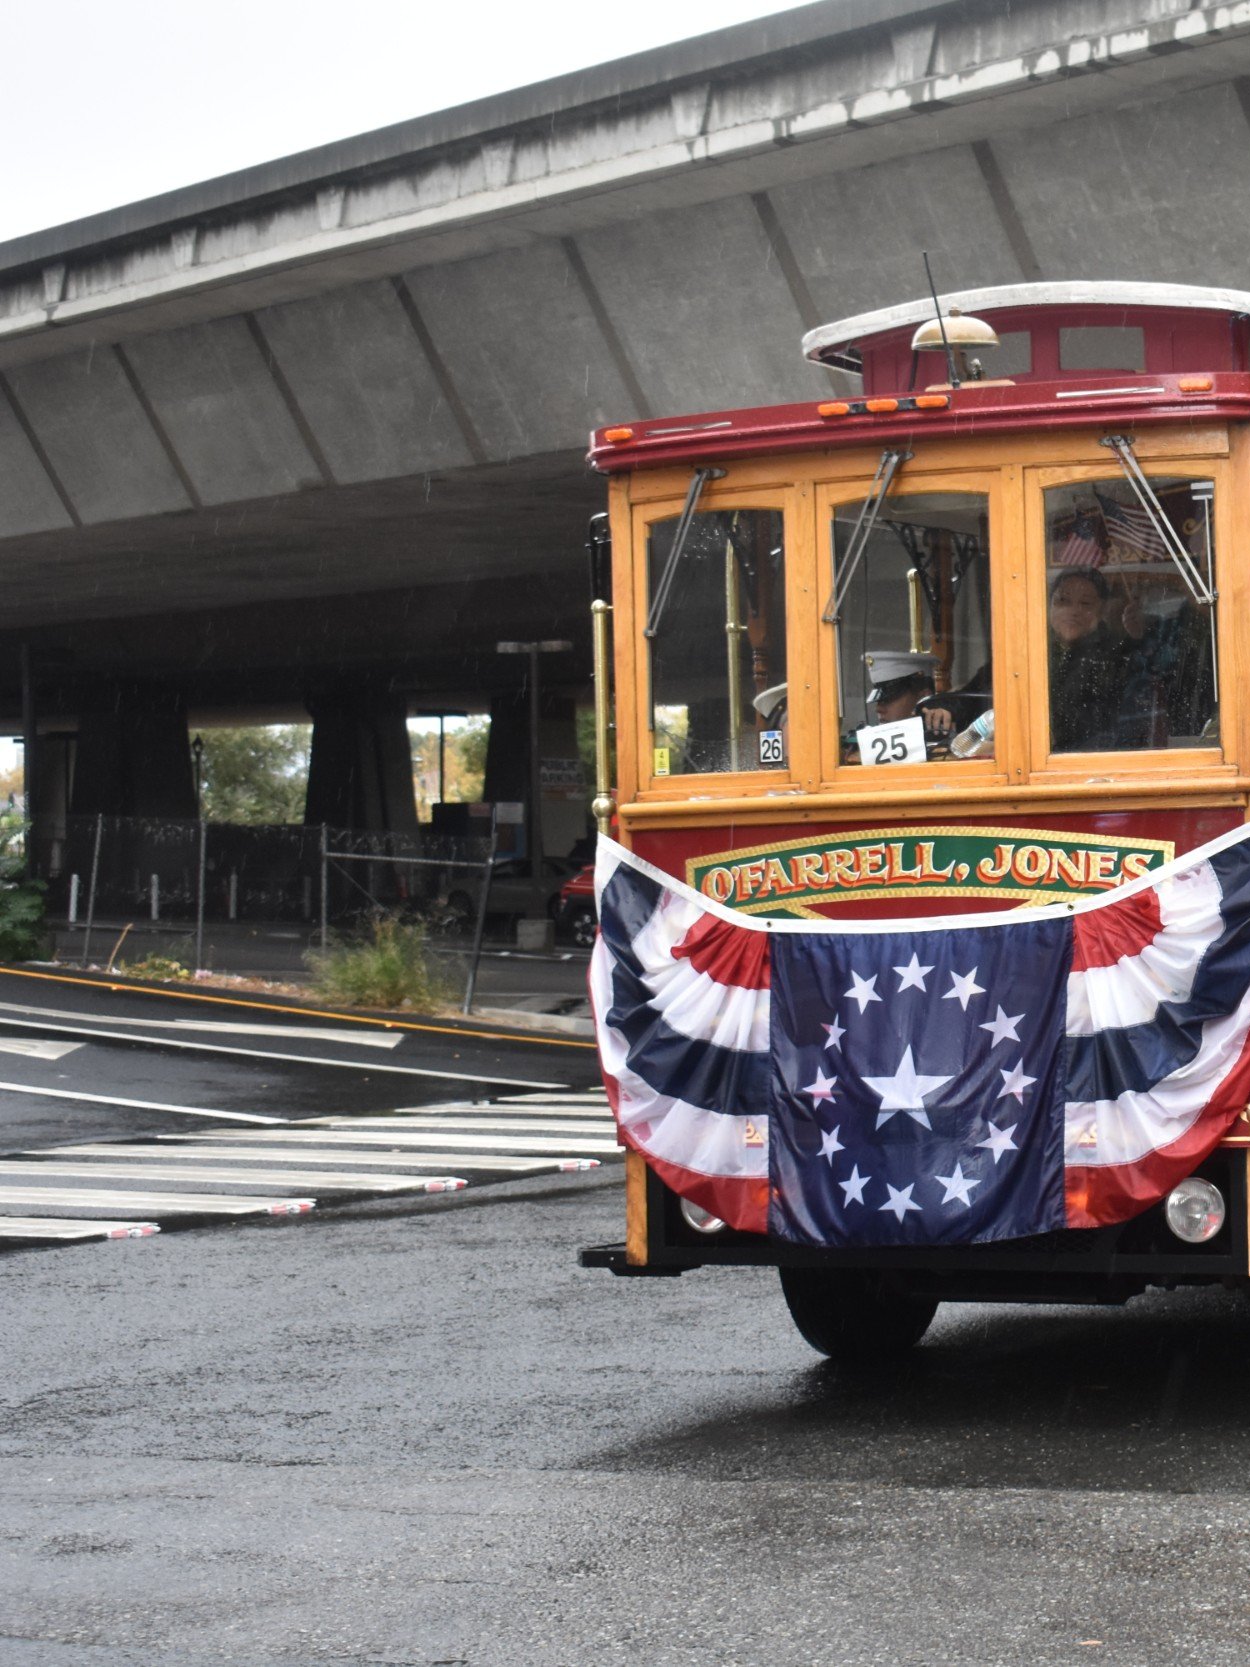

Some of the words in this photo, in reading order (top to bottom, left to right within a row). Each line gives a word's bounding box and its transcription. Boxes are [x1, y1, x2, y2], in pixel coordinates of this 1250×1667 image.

[761, 738, 782, 760] 26
[870, 732, 909, 765] 25
[976, 843, 1154, 889] JONES
